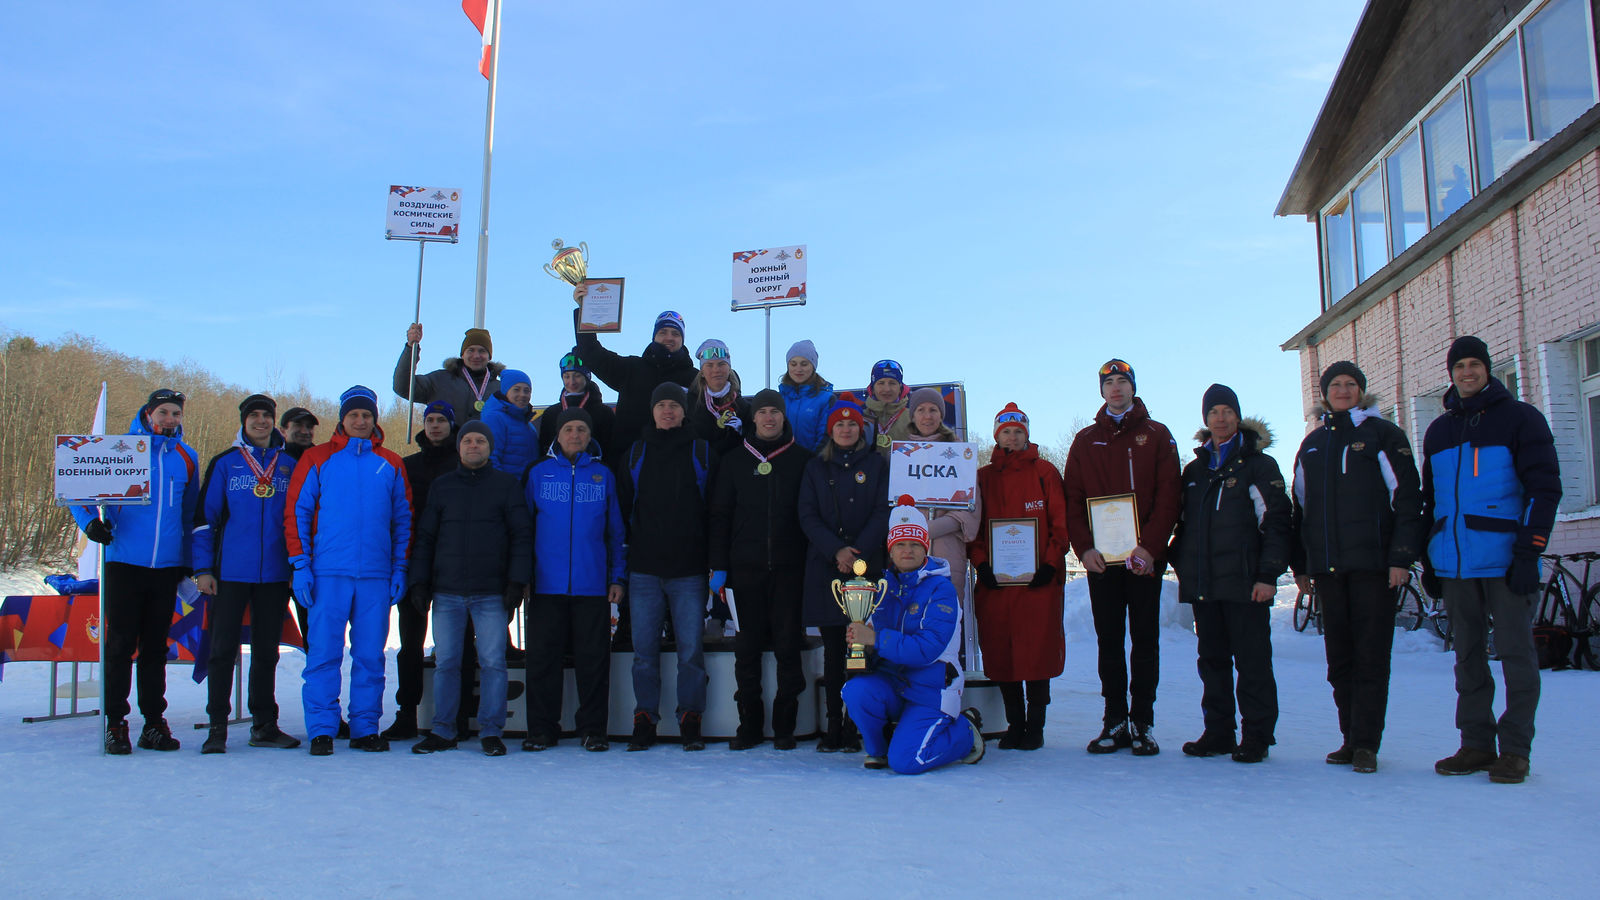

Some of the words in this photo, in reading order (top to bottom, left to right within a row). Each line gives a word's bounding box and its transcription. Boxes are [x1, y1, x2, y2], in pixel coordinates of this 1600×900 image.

[399, 201, 449, 210] ВОЗДУШНО-
[393, 210, 454, 219] КОСМИЧЕСКИЕ
[751, 263, 787, 273] ЮЖНЫЙ
[748, 273, 790, 283] ВОЕННЫЙ
[755, 284, 782, 293] ОКРУГ
[73, 454, 134, 465] ЗАПАДНЫЙ
[58, 466, 112, 476] ВОЕННЫЙ
[114, 468, 149, 476] ОКРУГ
[907, 463, 958, 480] ЦСКА
